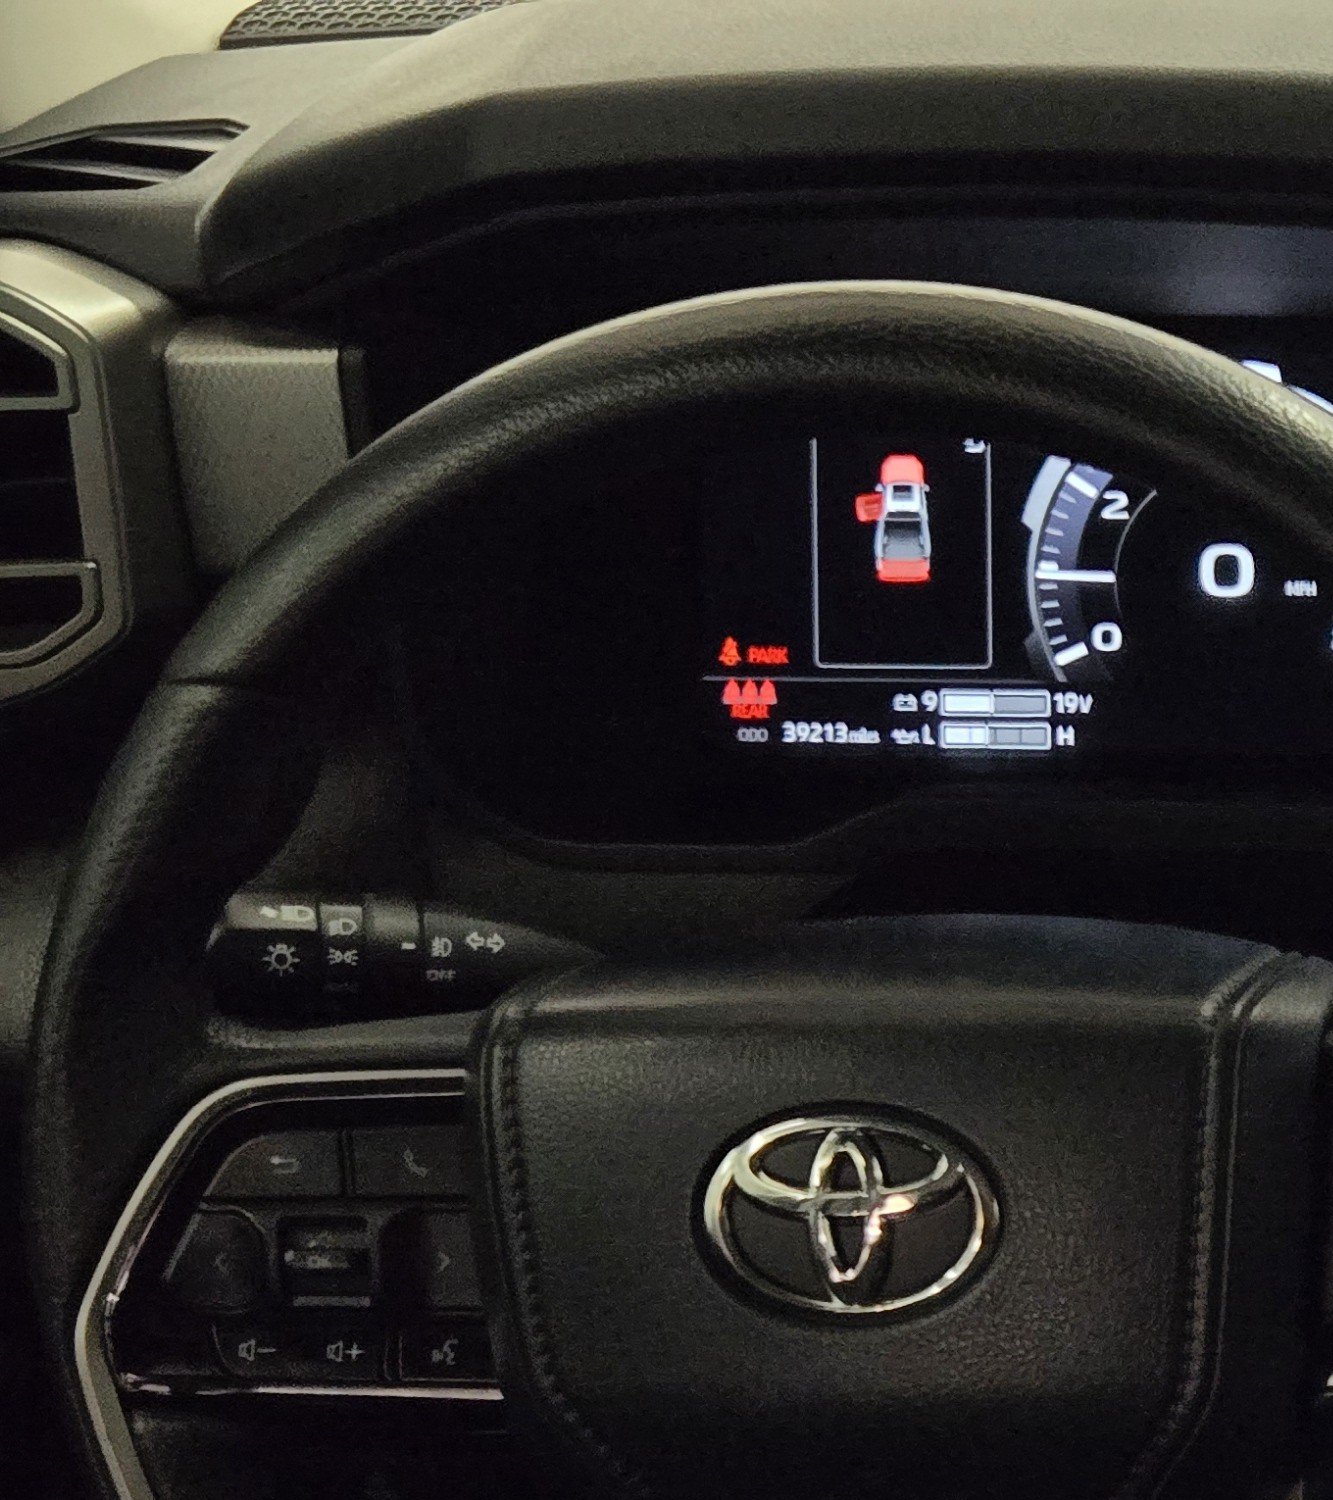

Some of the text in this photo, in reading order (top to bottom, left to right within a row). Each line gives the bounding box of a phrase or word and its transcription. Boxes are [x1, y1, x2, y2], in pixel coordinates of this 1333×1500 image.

[1100, 491, 1130, 520] 2
[1199, 541, 1256, 598] 0
[1091, 622, 1123, 652] 0
[920, 690, 938, 712] 9
[1053, 692, 1094, 714] 19V
[921, 723, 936, 745] L
[1055, 725, 1076, 746] H
